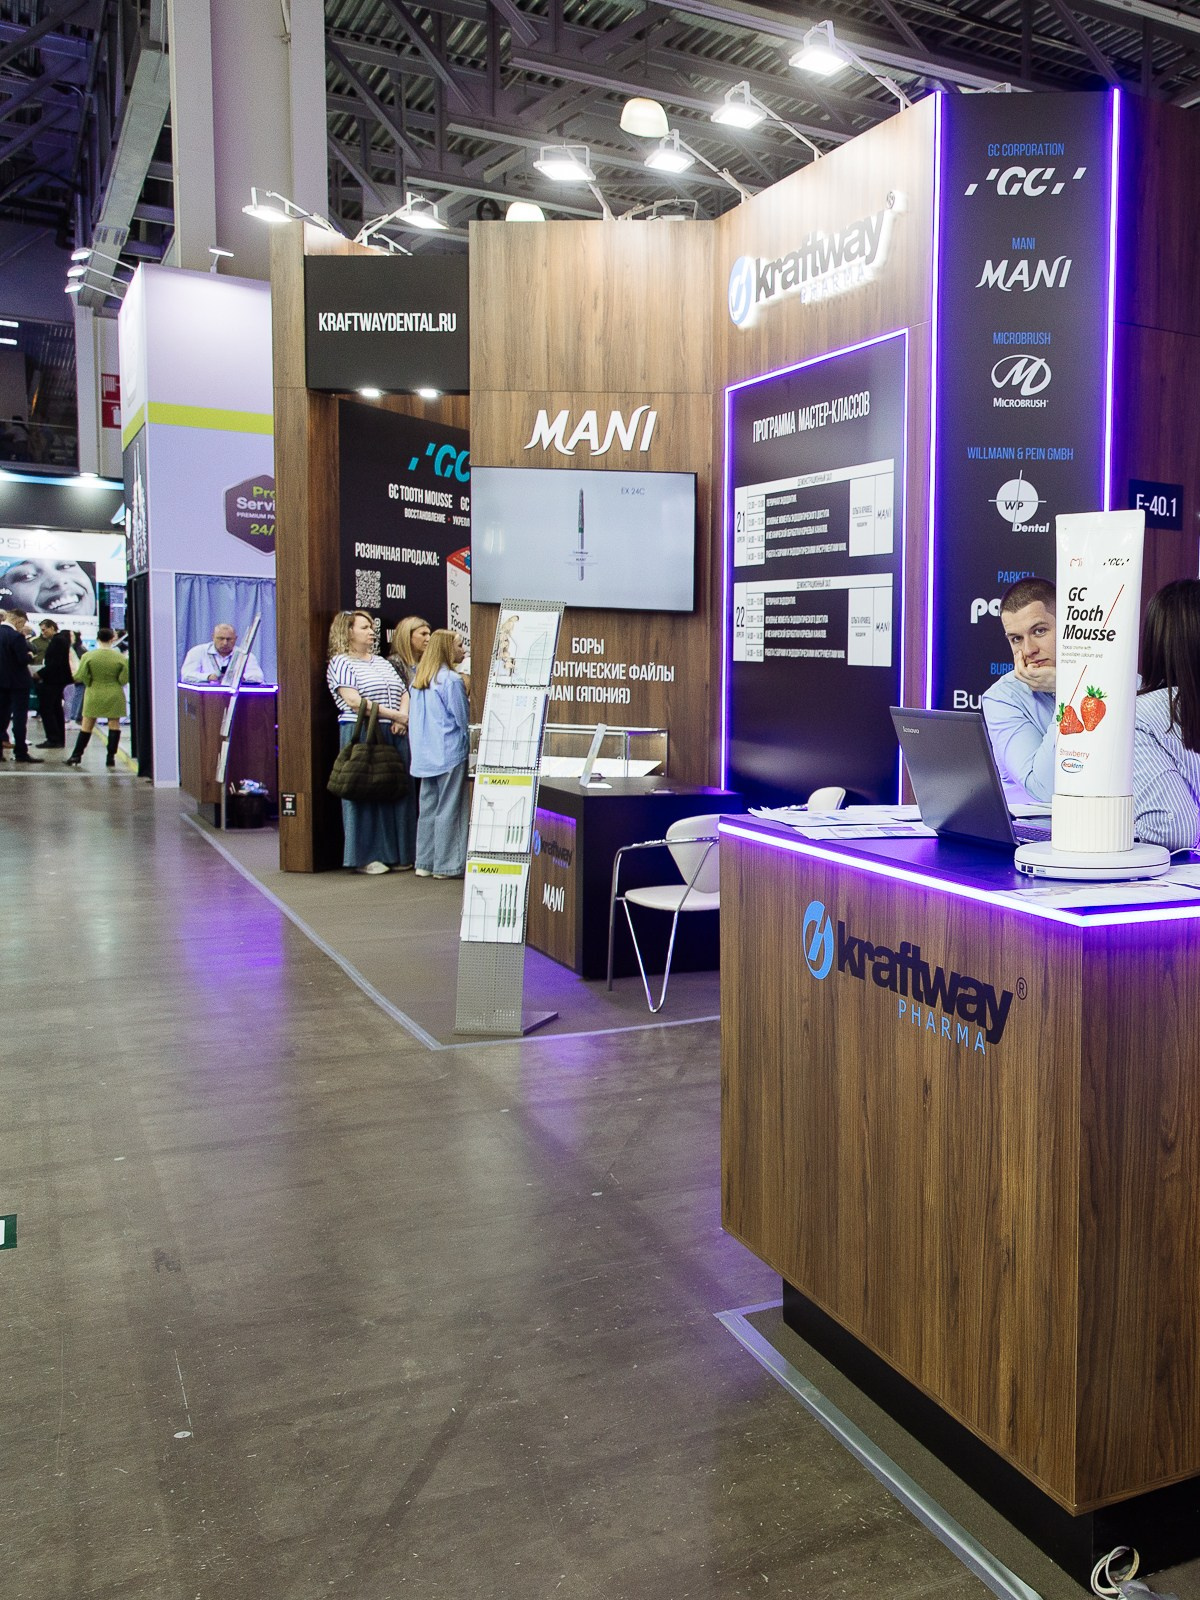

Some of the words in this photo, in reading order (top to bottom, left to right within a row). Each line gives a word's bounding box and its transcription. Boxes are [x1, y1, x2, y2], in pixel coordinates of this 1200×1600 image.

[987, 144, 1000, 157] GC
[1001, 143, 1065, 157] CORPORATION
[1011, 237, 1036, 250] MANI
[755, 209, 885, 303] kraftway
[975, 255, 1073, 292] MANI
[318, 312, 457, 333] KRAFTWAYDENTAL.RU
[992, 332, 1051, 345] MICROBRUSH
[752, 411, 796, 443] ПРОГРАММА
[798, 391, 871, 432] МАСТЕР-КЛАССОВ
[523, 405, 657, 456] MANI
[967, 447, 1015, 460] WILLMANN
[1017, 447, 1024, 460] &
[1025, 447, 1046, 460] PEIN
[1047, 448, 1074, 461] GMBH
[388, 483, 399, 499] GC
[400, 485, 424, 504] TOOTH
[424, 490, 453, 509] MOUSSE
[460, 496, 470, 511] GC
[1136, 493, 1177, 517] E-40.1
[236, 511, 266, 519] PREMIUM
[736, 511, 746, 533] 21
[1013, 523, 1050, 533] Dental
[355, 542, 400, 562] РОЗНИЧНАЯ
[401, 547, 440, 566] ПРОДАЖА:
[997, 571, 1035, 583] PARK
[386, 583, 406, 599] OZON
[1068, 586, 1088, 602] GC
[450, 602, 460, 615] GC
[736, 606, 745, 628] 22
[1066, 604, 1104, 622] Tooth
[450, 615, 469, 633] Tooth
[1062, 624, 1117, 642] Mousse
[572, 637, 604, 655] БОРЫ
[551, 661, 627, 680] ОНТИЧЕСКИЕ
[628, 662, 675, 682] ФАЙЛЫ
[576, 685, 631, 704] (ЯПОНИЯ)
[1059, 748, 1090, 760] Strawberry
[542, 882, 565, 913] MANI
[837, 920, 1013, 1045] kraftway
[898, 999, 986, 1055] PHARMA
